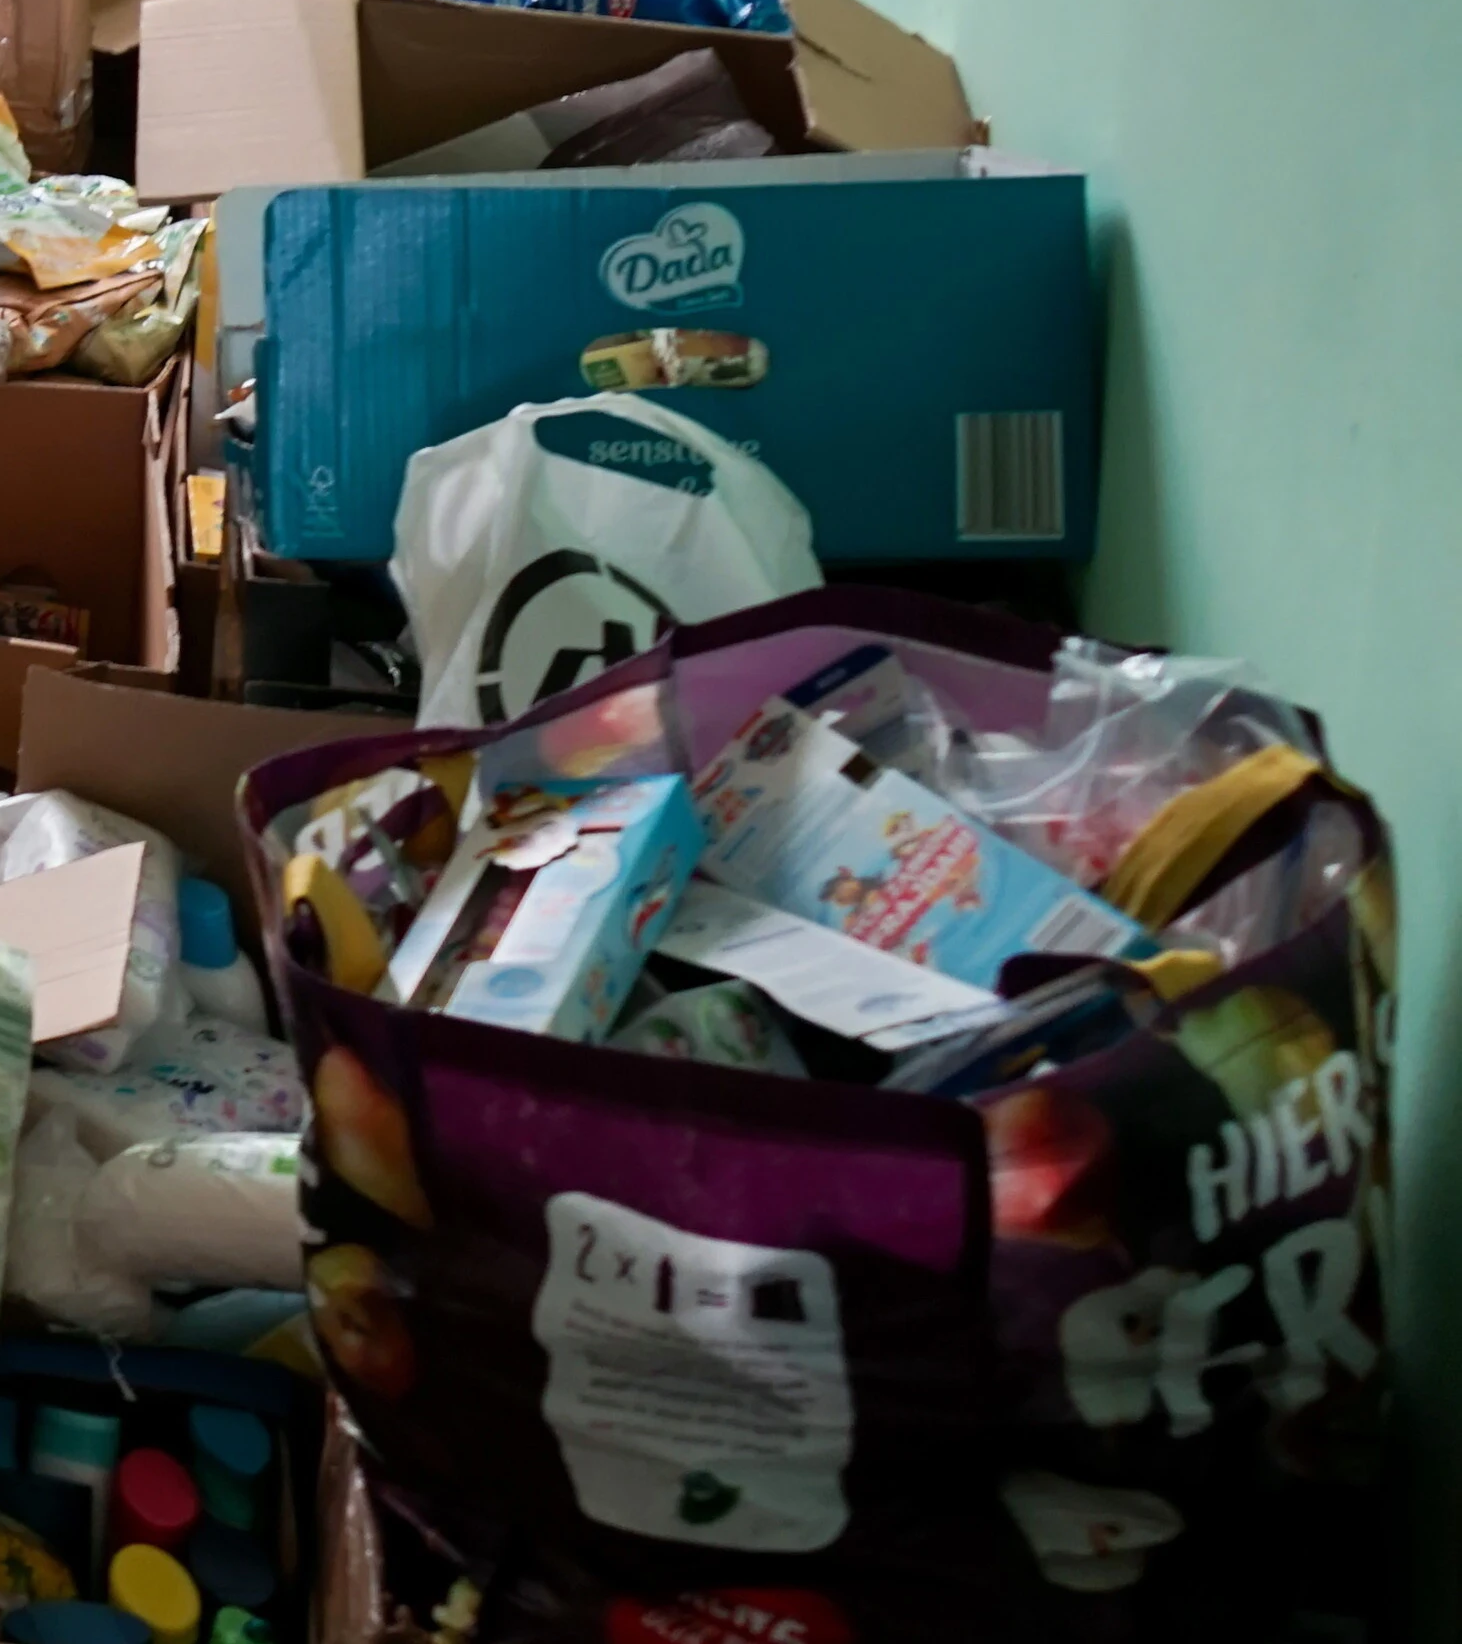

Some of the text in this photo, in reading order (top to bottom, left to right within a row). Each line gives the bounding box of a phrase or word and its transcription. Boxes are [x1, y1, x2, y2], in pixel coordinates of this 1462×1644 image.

[617, 244, 735, 295] Dada
[1186, 1050, 1375, 1244] HIER
[574, 1222, 598, 1285] 2
